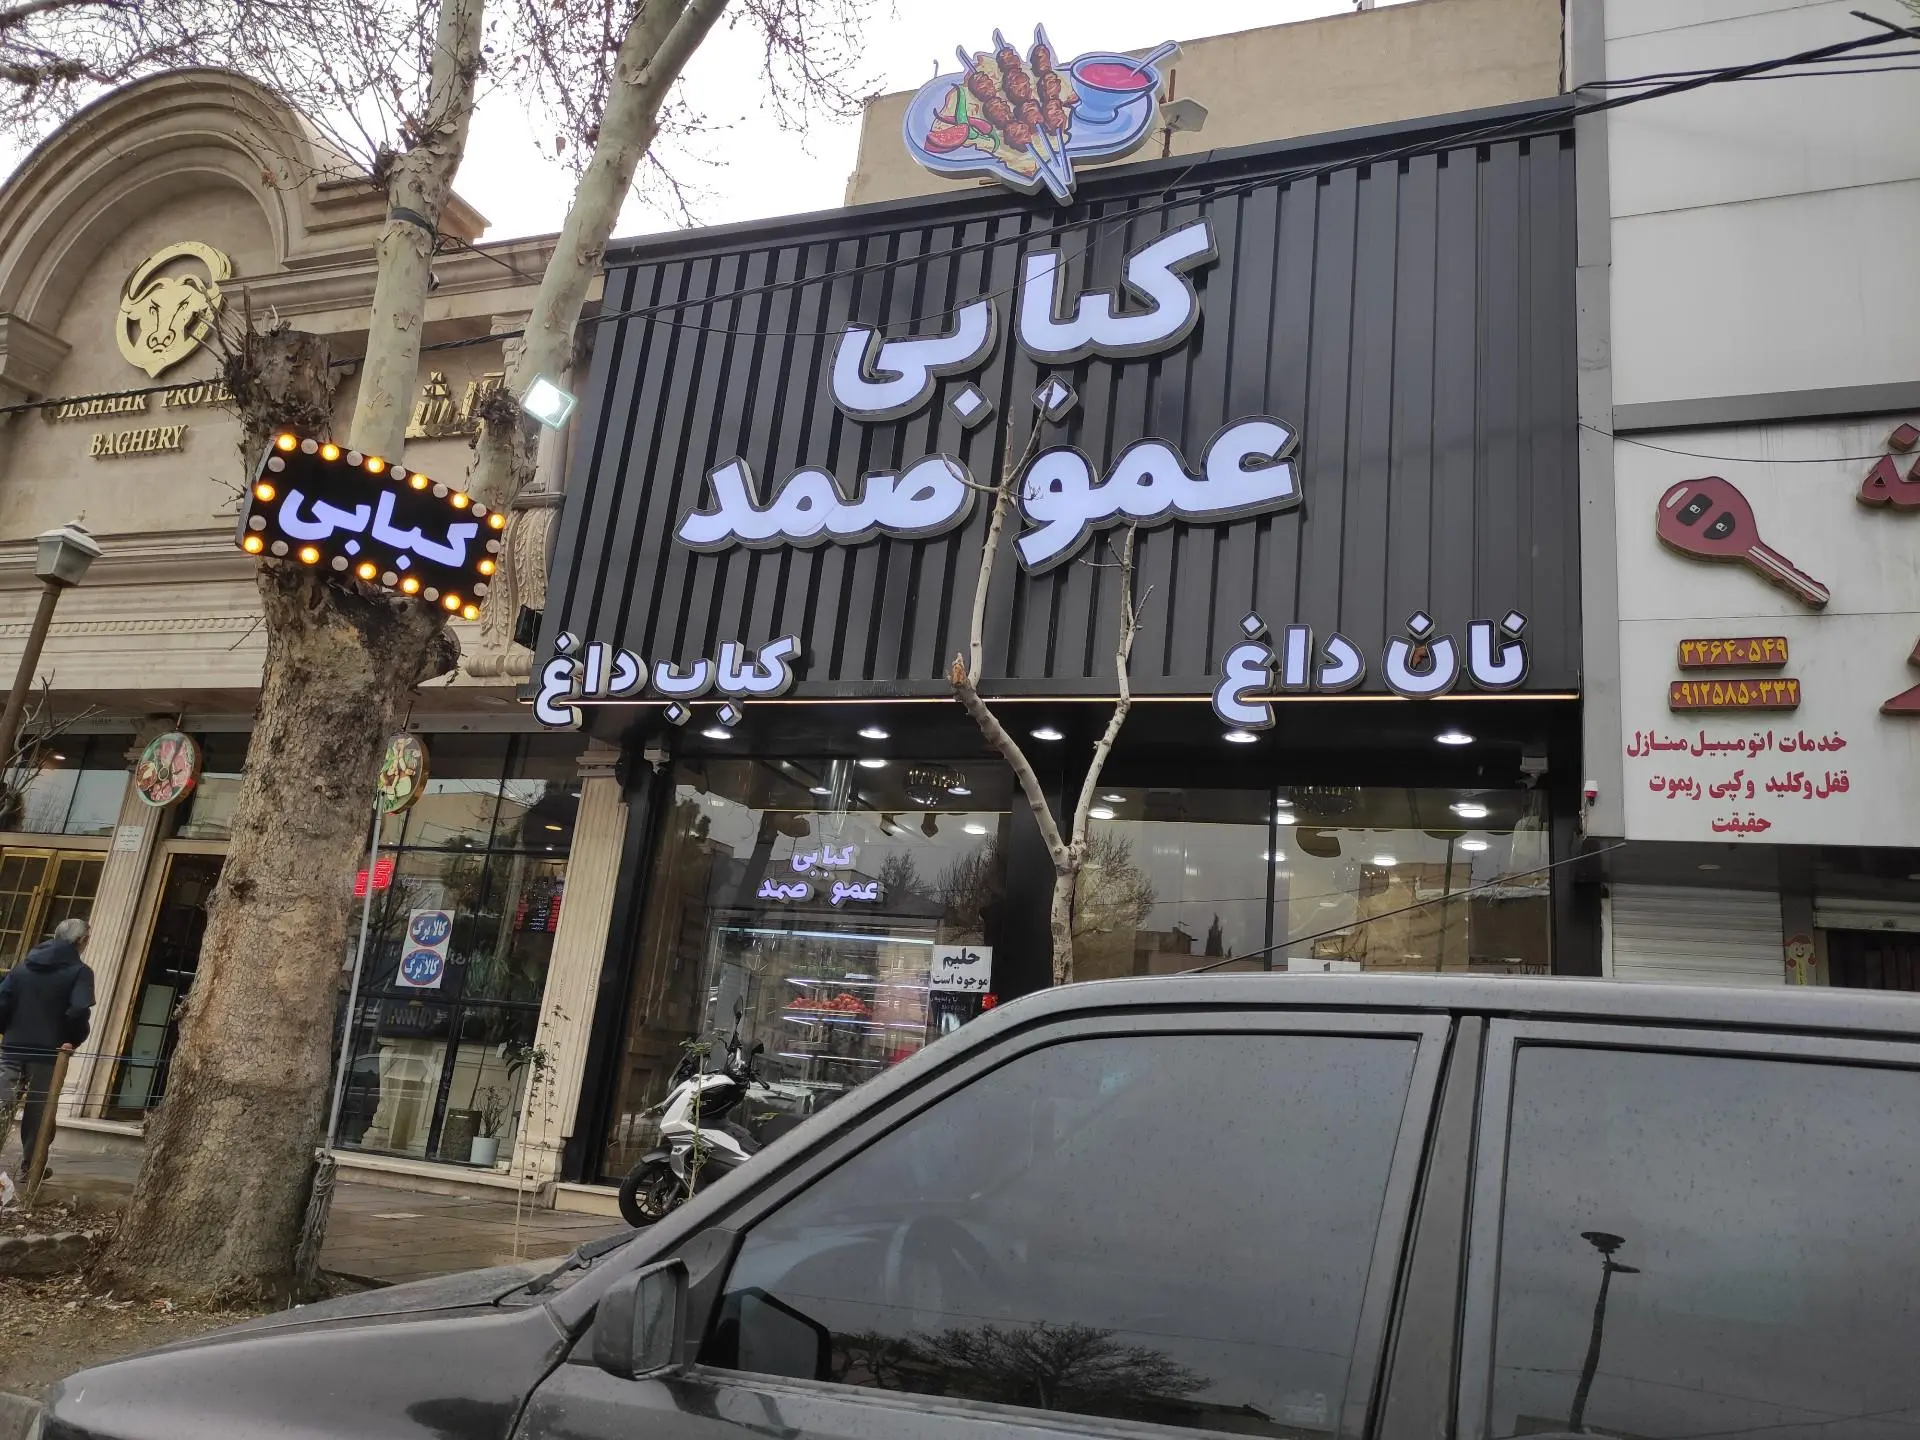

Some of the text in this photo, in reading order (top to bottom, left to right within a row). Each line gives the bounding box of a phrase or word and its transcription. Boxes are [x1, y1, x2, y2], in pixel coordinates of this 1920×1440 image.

[831, 218, 1217, 427] کبابی
[89, 424, 190, 456] BAGHERY
[675, 414, 1302, 575] عمو صمد
[277, 487, 480, 571] کبابی
[1680, 638, 1788, 664] ۳۴۶۴۰۵۴۹
[533, 631, 801, 728] کباب داغ
[1212, 609, 1530, 729] نان داغ
[1673, 679, 1798, 705] ۰۹۱۲۵۸۵۰۳۳۲
[1626, 730, 1847, 758] خدمات اتومبیل منازل
[1649, 775, 1701, 800] ریموت
[1815, 769, 1850, 799] قفل
[1711, 811, 1772, 838] حقیقت
[791, 844, 855, 878] کبابی
[757, 878, 879, 907] عمو صمد
[942, 947, 981, 970] حلیم
[932, 973, 988, 990] موجود است
